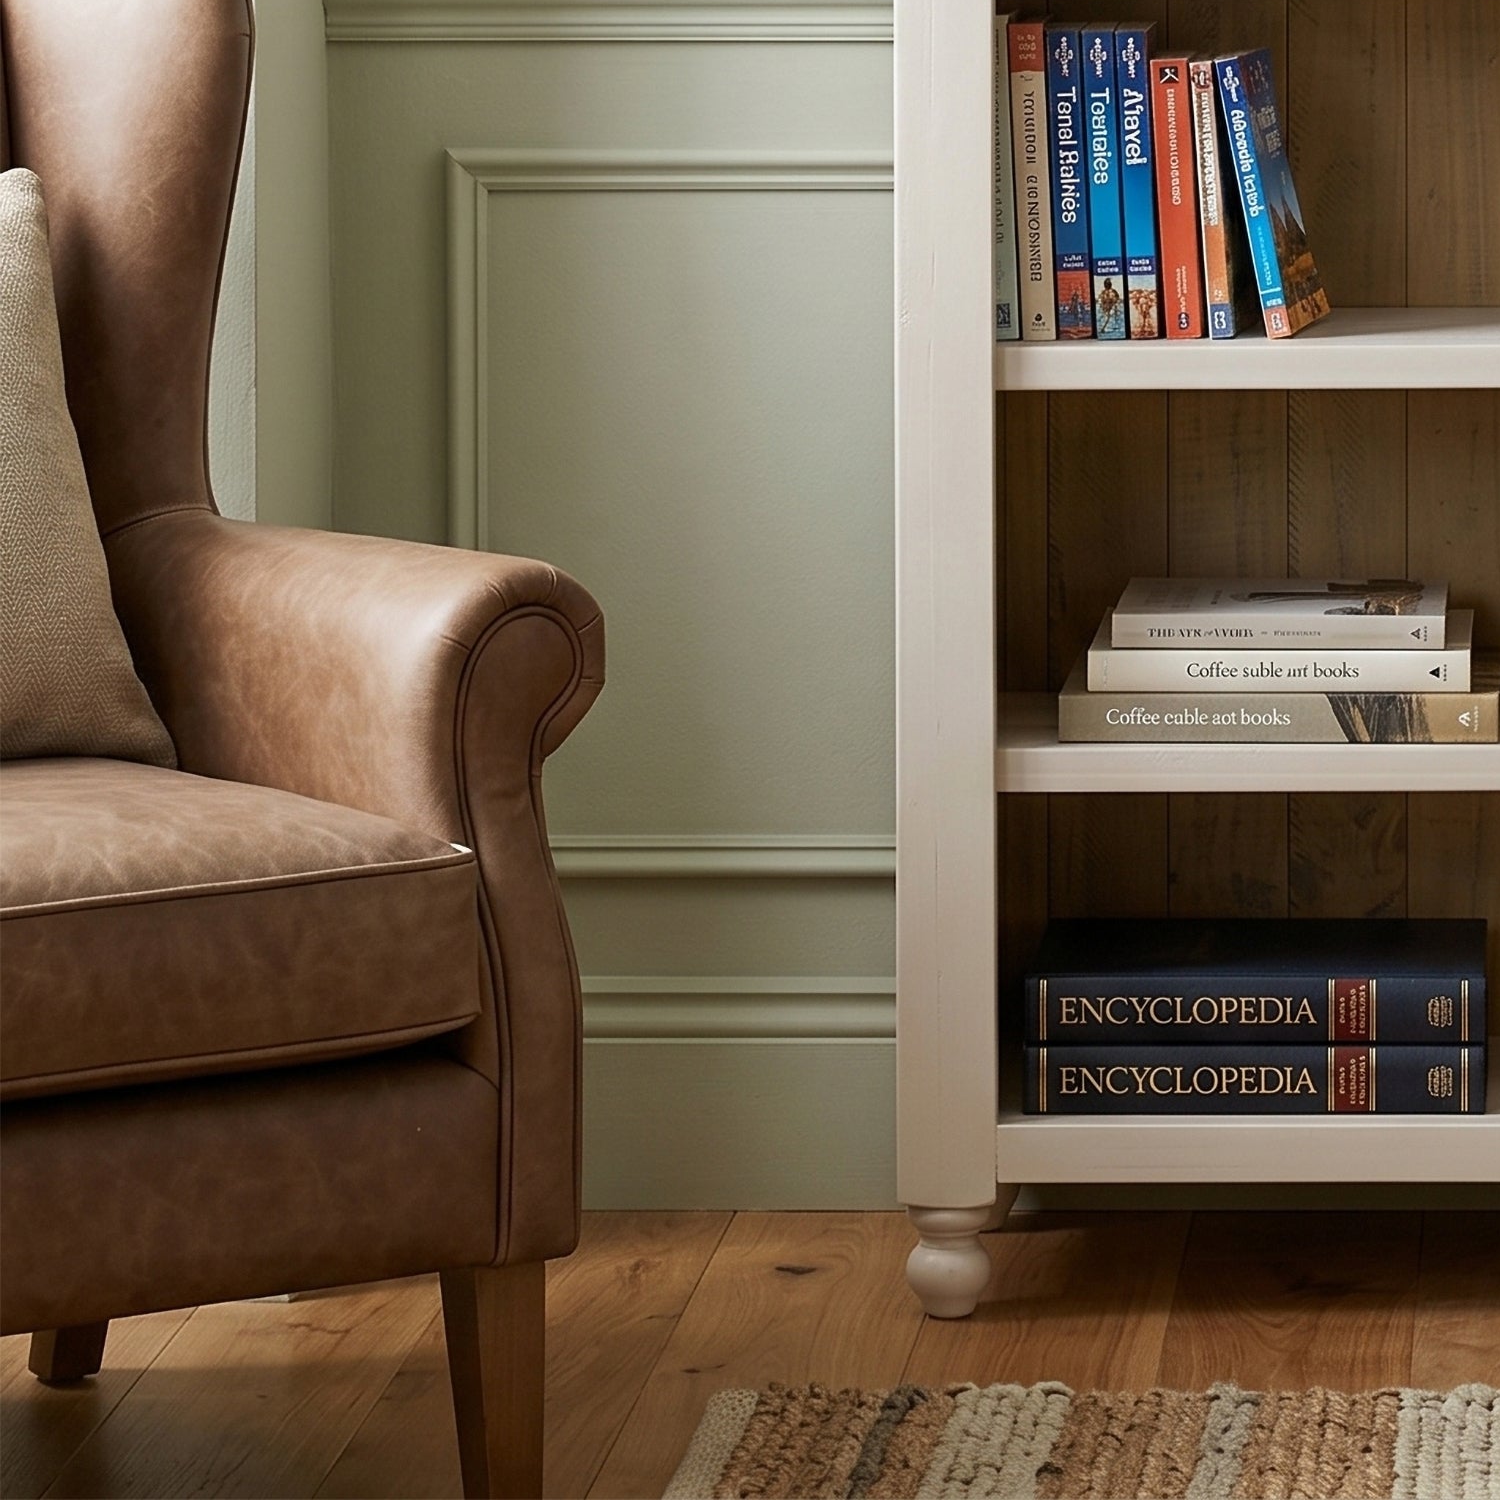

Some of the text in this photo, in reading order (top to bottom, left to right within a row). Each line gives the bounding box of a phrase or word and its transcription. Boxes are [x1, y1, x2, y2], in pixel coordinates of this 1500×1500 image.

[1186, 662, 1238, 678] Coffee
[1242, 662, 1283, 678] suble
[1313, 662, 1360, 678] books
[1106, 707, 1160, 725] Coffee
[1241, 707, 1291, 726] books
[1059, 997, 1318, 1025] ENCYCLOPEDIA
[1059, 1066, 1318, 1095] ENCYCLOPEDIA
